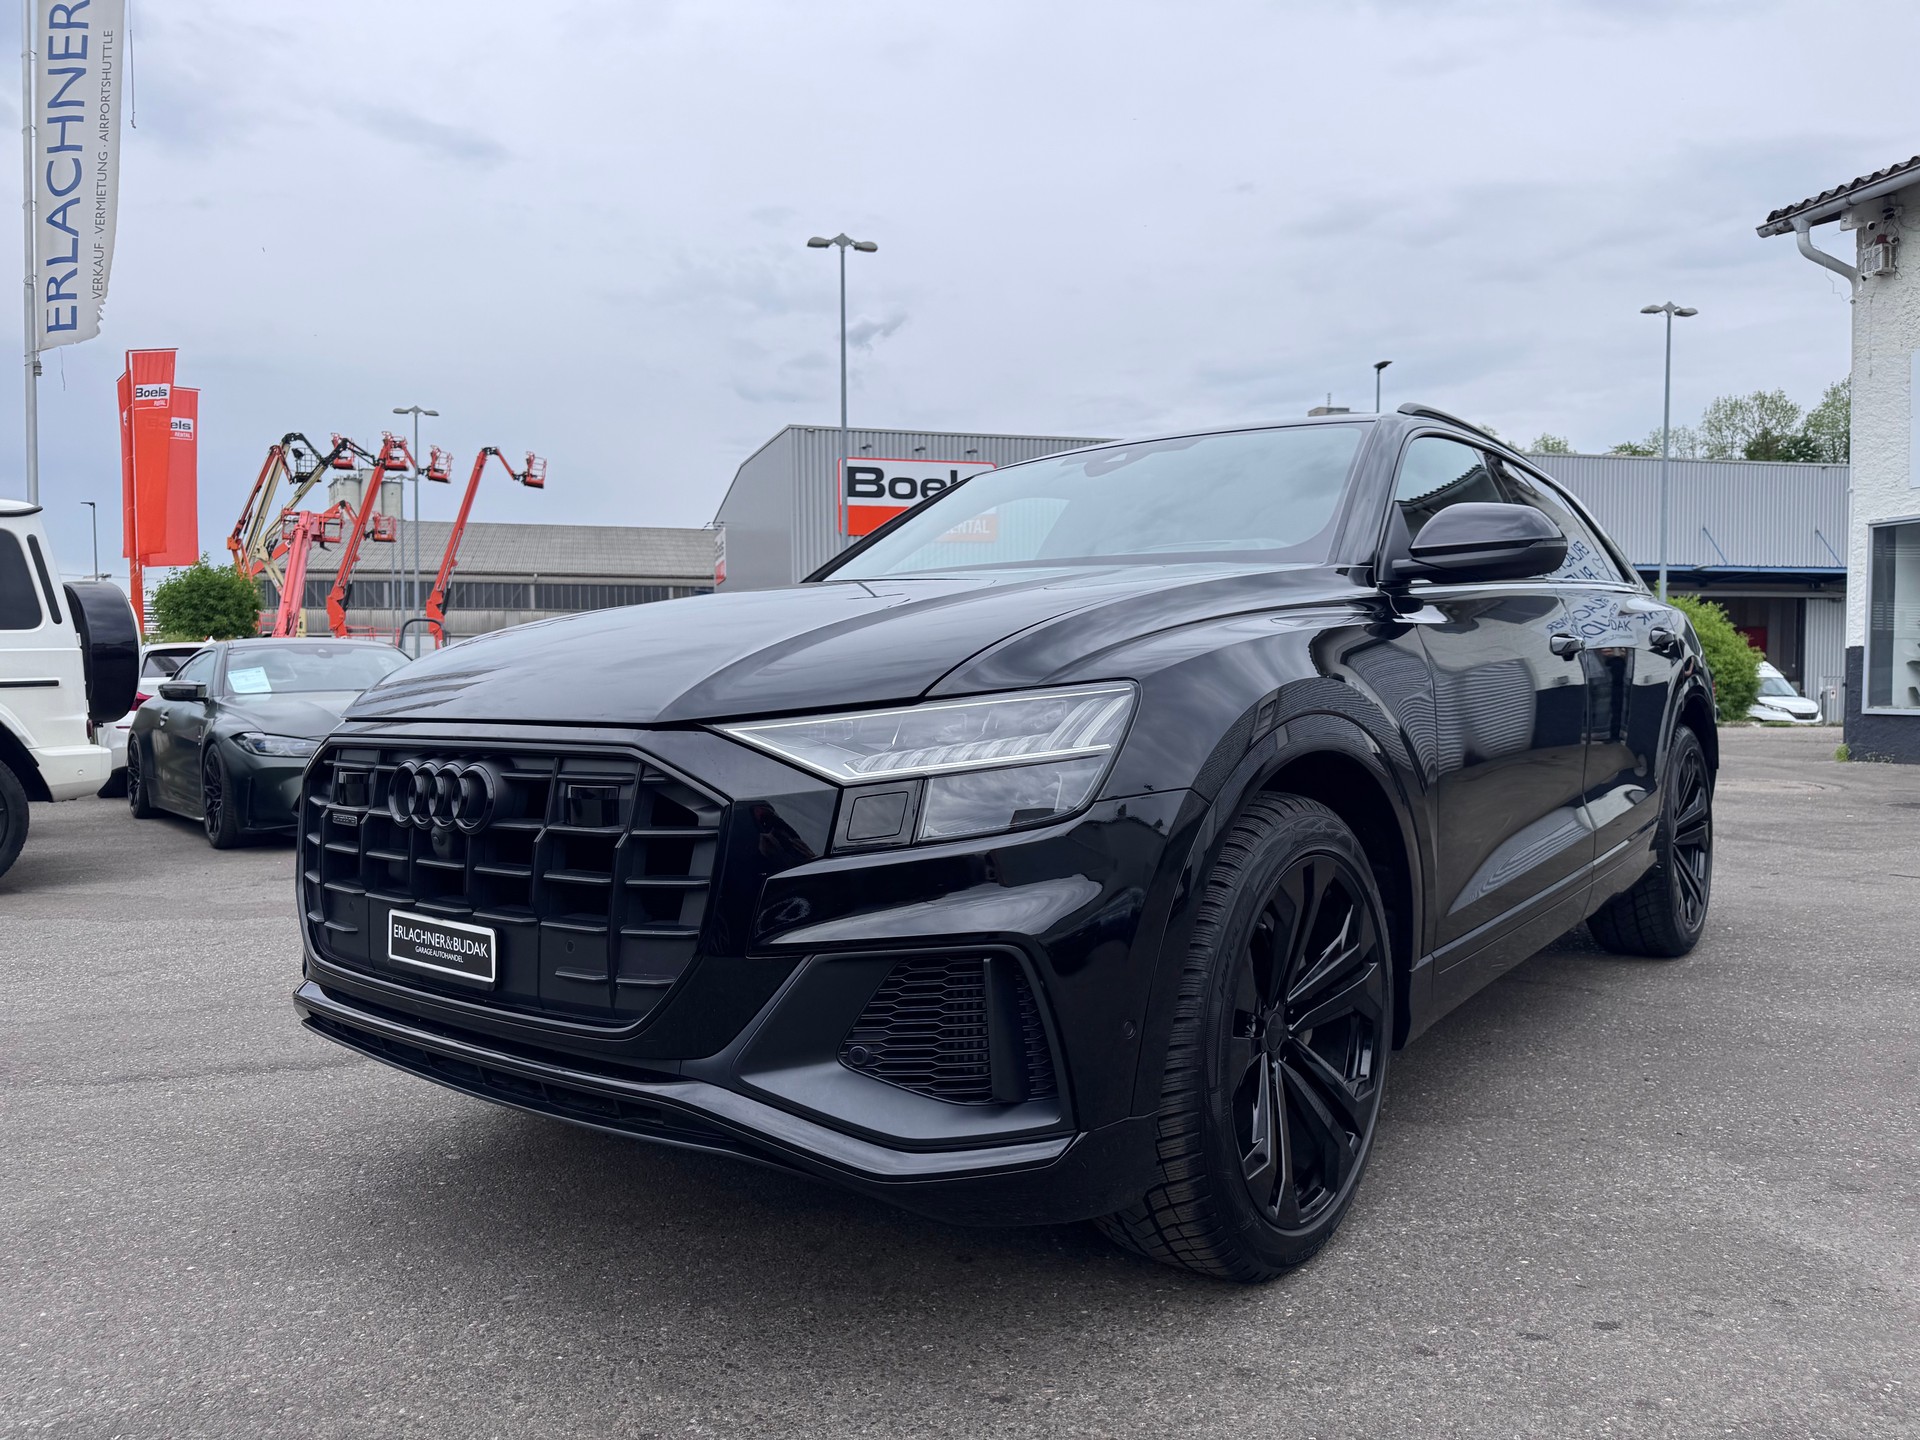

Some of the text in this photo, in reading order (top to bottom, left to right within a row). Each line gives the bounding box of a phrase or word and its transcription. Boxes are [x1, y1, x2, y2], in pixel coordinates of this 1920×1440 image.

[46, 0, 91, 333] ERLACHNER
[92, 30, 114, 299] VERKAUF VERMIETUNG AIRPORTSHUTTLE
[136, 387, 167, 398] Boels
[393, 924, 489, 958] ERLACHNER&BUDAK
[415, 945, 464, 963] GARAGE AUTOHANDEL
